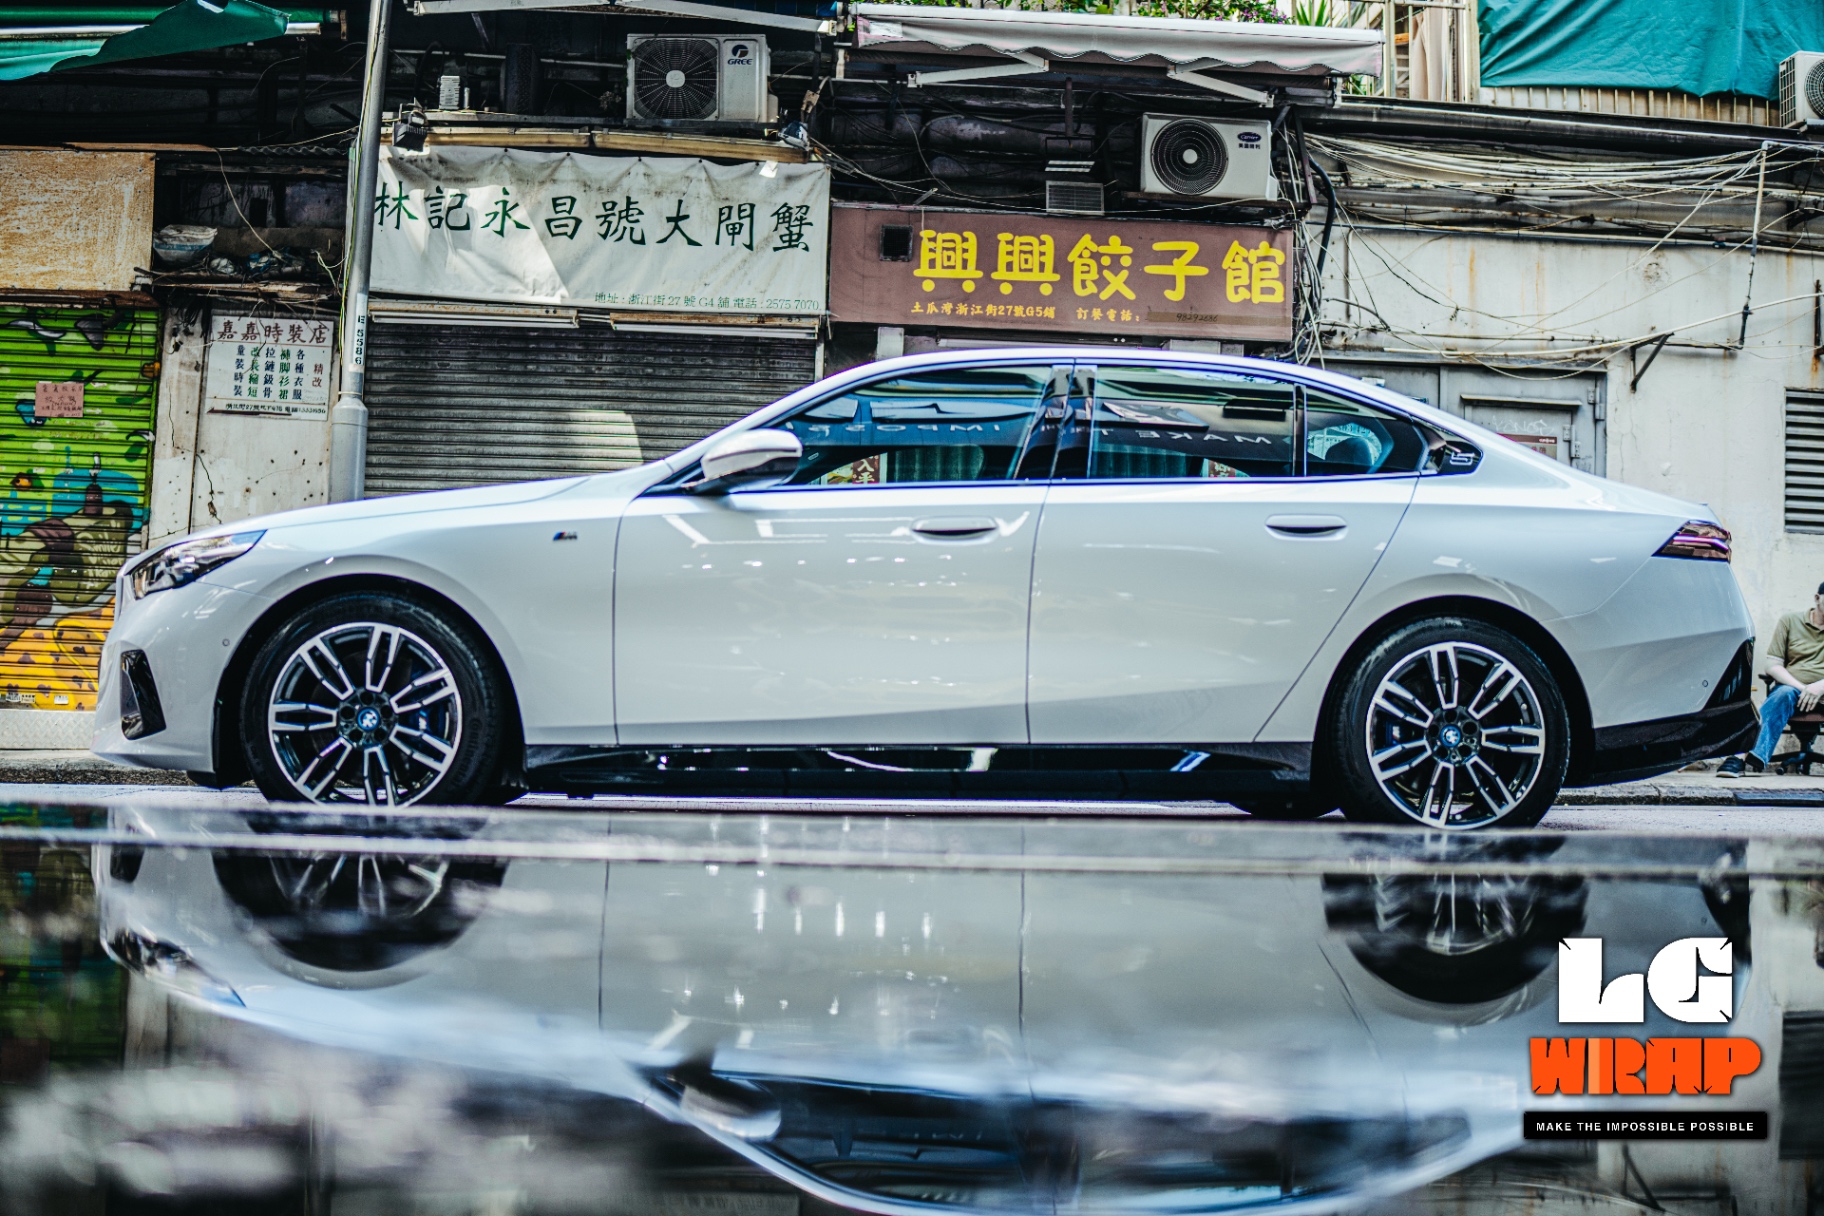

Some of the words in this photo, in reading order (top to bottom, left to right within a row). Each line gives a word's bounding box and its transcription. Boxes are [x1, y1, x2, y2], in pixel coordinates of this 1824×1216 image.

[374, 180, 813, 252] 林記永昌號大閘蟹
[913, 229, 1285, 303] 興興餃子館
[217, 320, 328, 343] 嘉嘉時裝店
